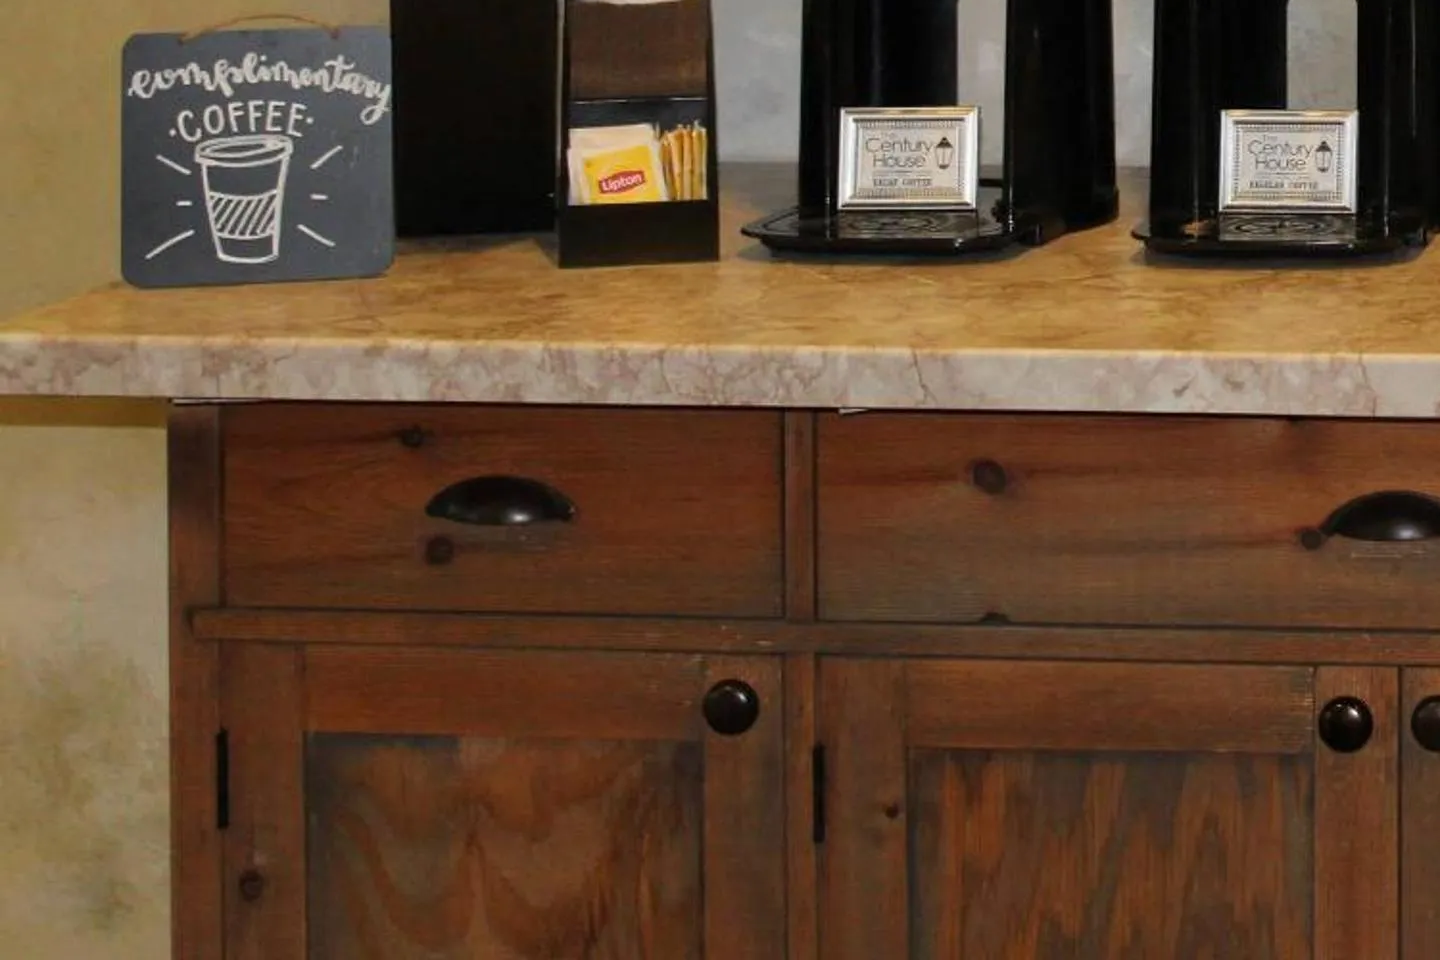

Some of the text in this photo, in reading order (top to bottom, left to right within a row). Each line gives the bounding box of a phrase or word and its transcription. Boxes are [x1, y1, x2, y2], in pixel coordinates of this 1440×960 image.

[128, 52, 392, 125] complimentary
[177, 100, 307, 142] COFFEE
[865, 137, 933, 155] Century
[1248, 140, 1314, 158] Century
[873, 154, 926, 168] House
[1255, 156, 1306, 171] House
[601, 172, 643, 192] Lipton
